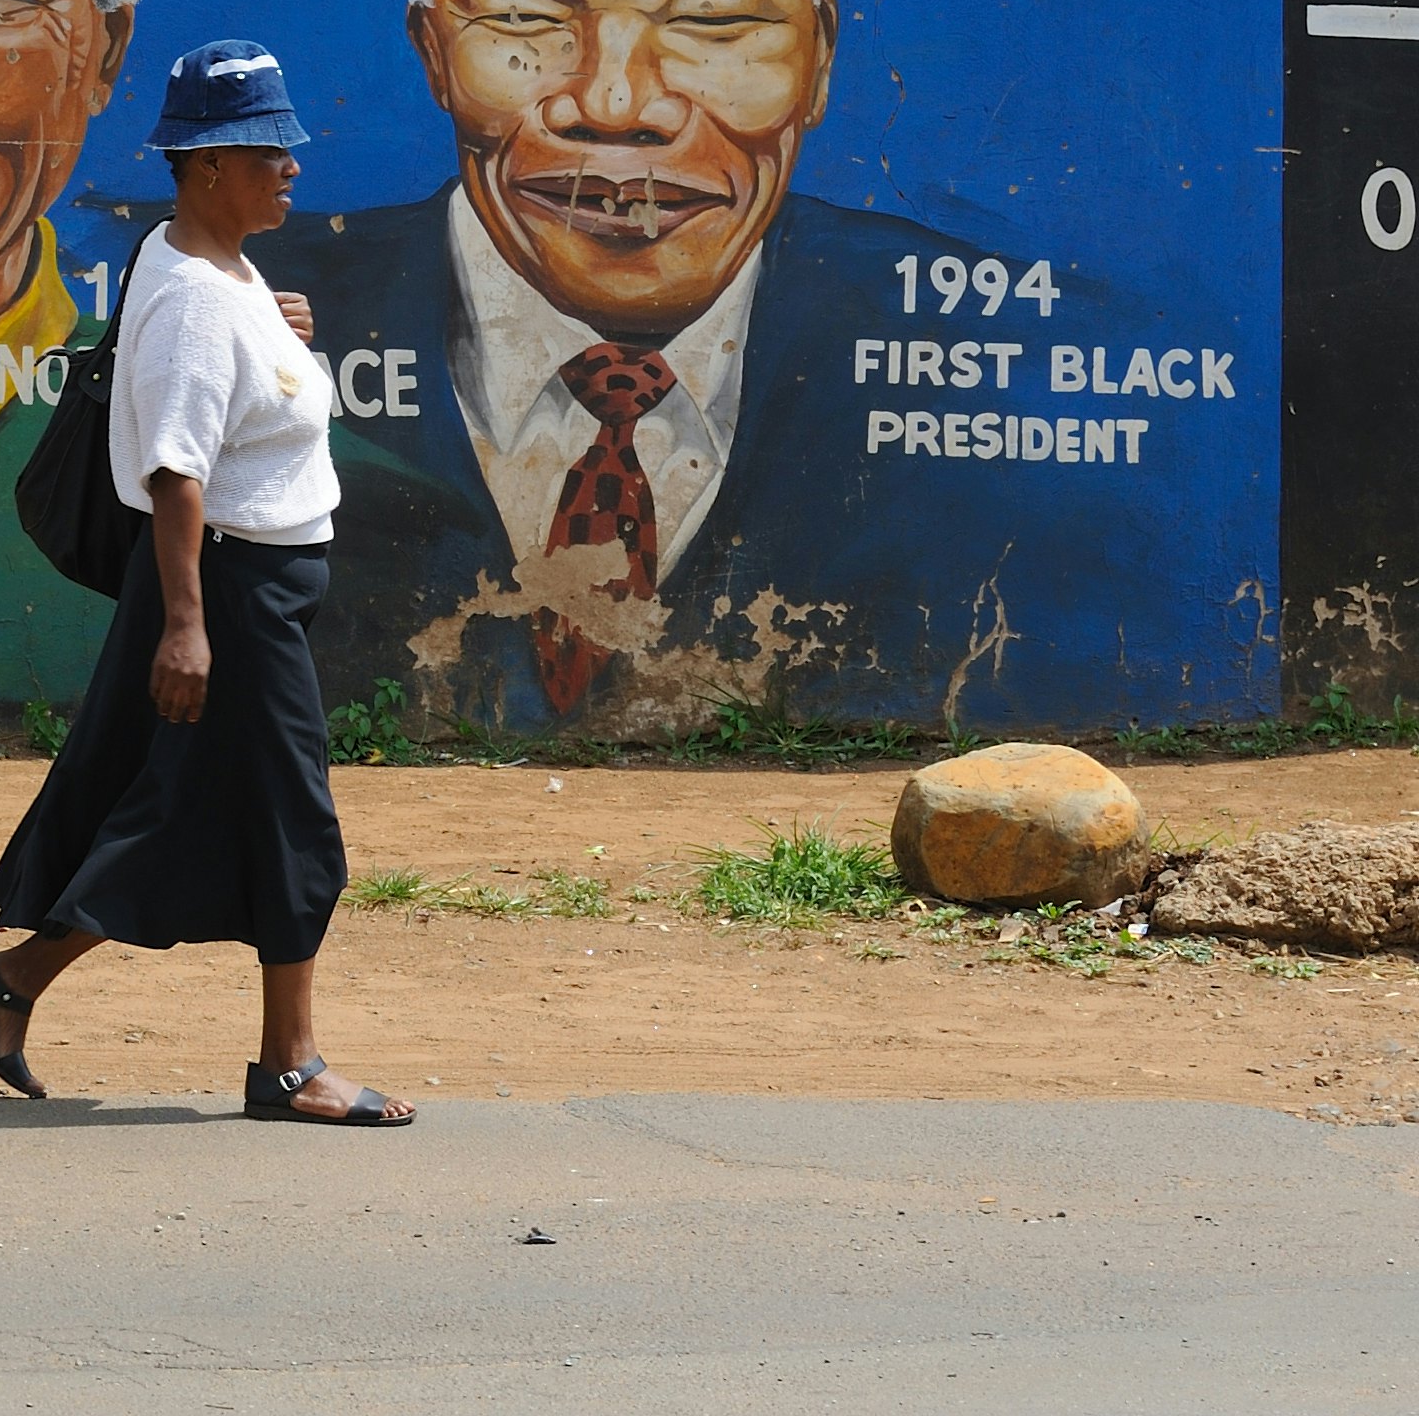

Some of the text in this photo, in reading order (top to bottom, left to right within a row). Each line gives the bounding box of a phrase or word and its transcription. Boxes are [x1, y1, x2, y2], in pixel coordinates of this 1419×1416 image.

[894, 254, 1061, 317] 1994
[854, 338, 1236, 399] FIRST BLACK
[866, 410, 1149, 465] PRESIDENT
